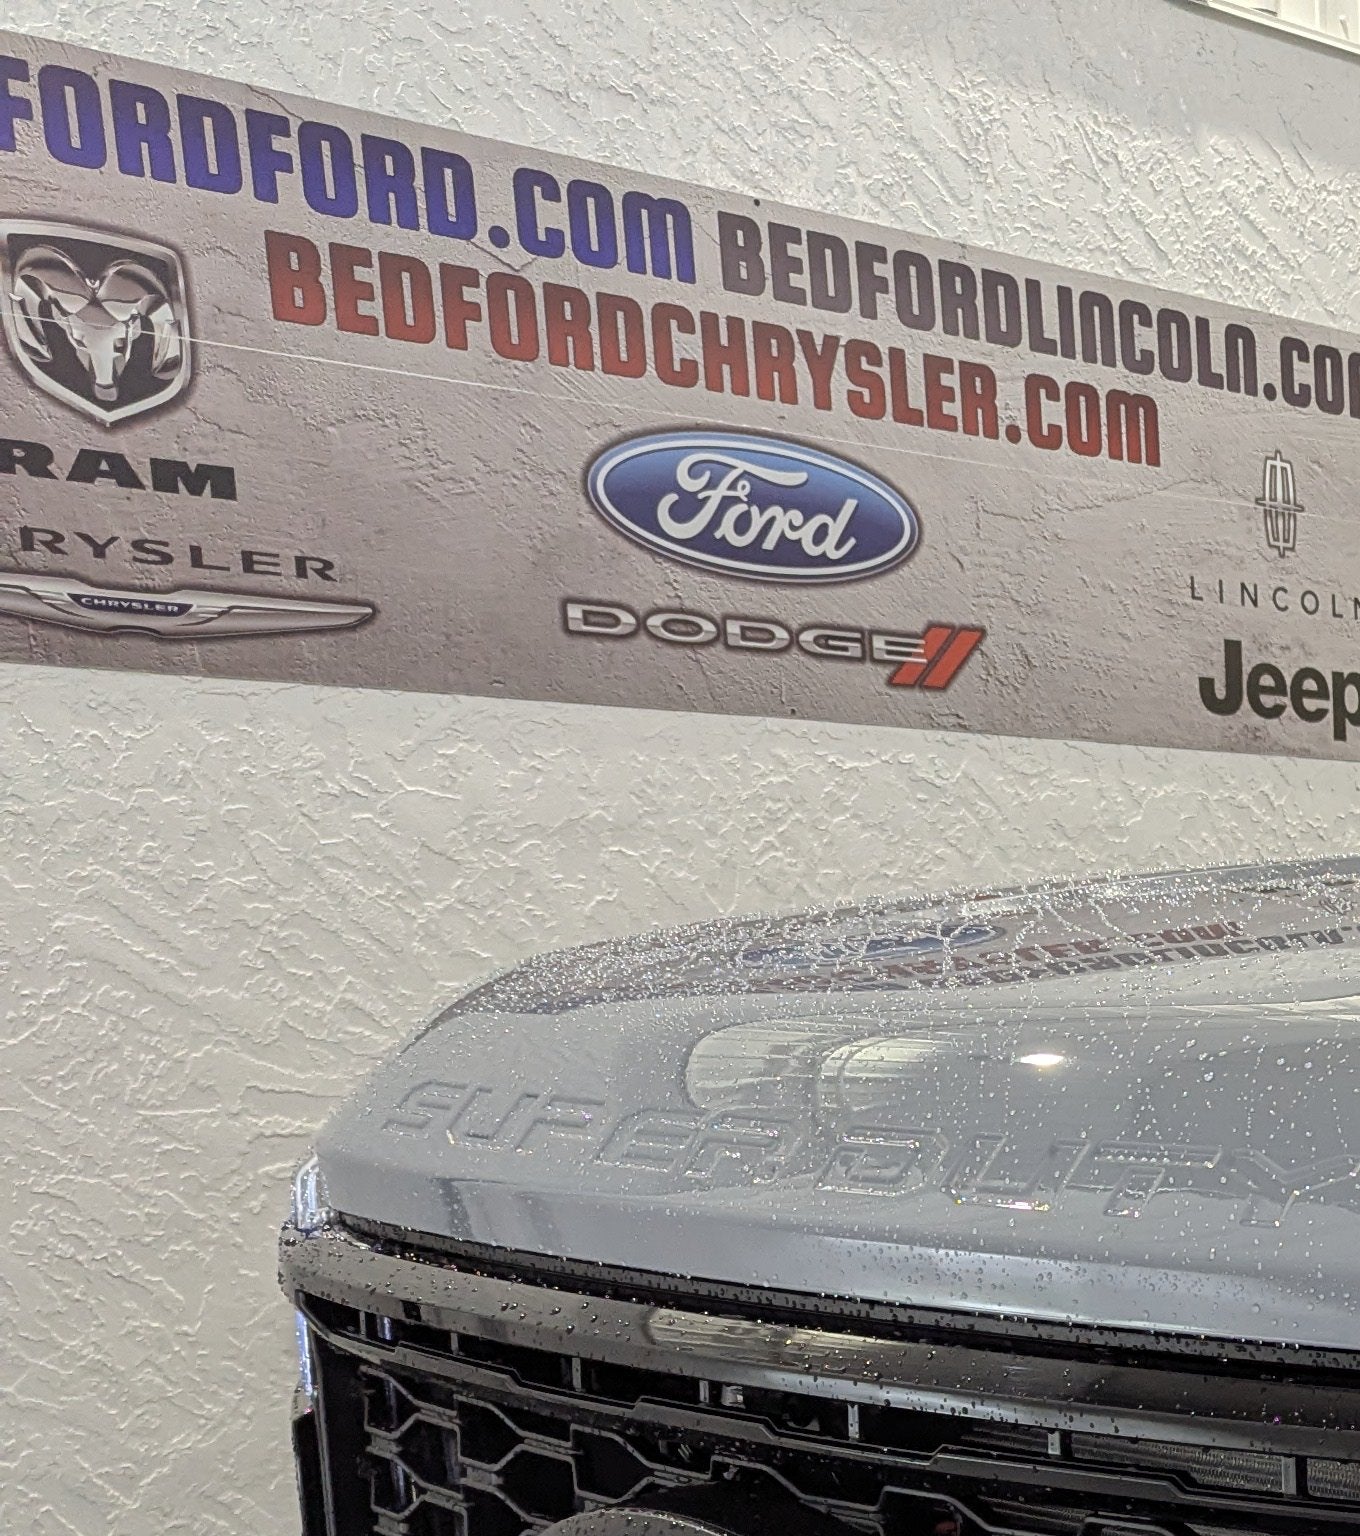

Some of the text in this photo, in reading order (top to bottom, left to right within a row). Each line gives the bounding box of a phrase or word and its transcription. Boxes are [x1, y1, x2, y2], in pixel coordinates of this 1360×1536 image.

[264, 229, 1161, 467] BEDFORDCHRYSLER.COM
[0, 438, 238, 501] RAM
[657, 453, 858, 560] Ford
[80, 597, 179, 613] CHRYSLER
[567, 603, 928, 665] DODGE
[382, 1078, 801, 1186] SUPER
